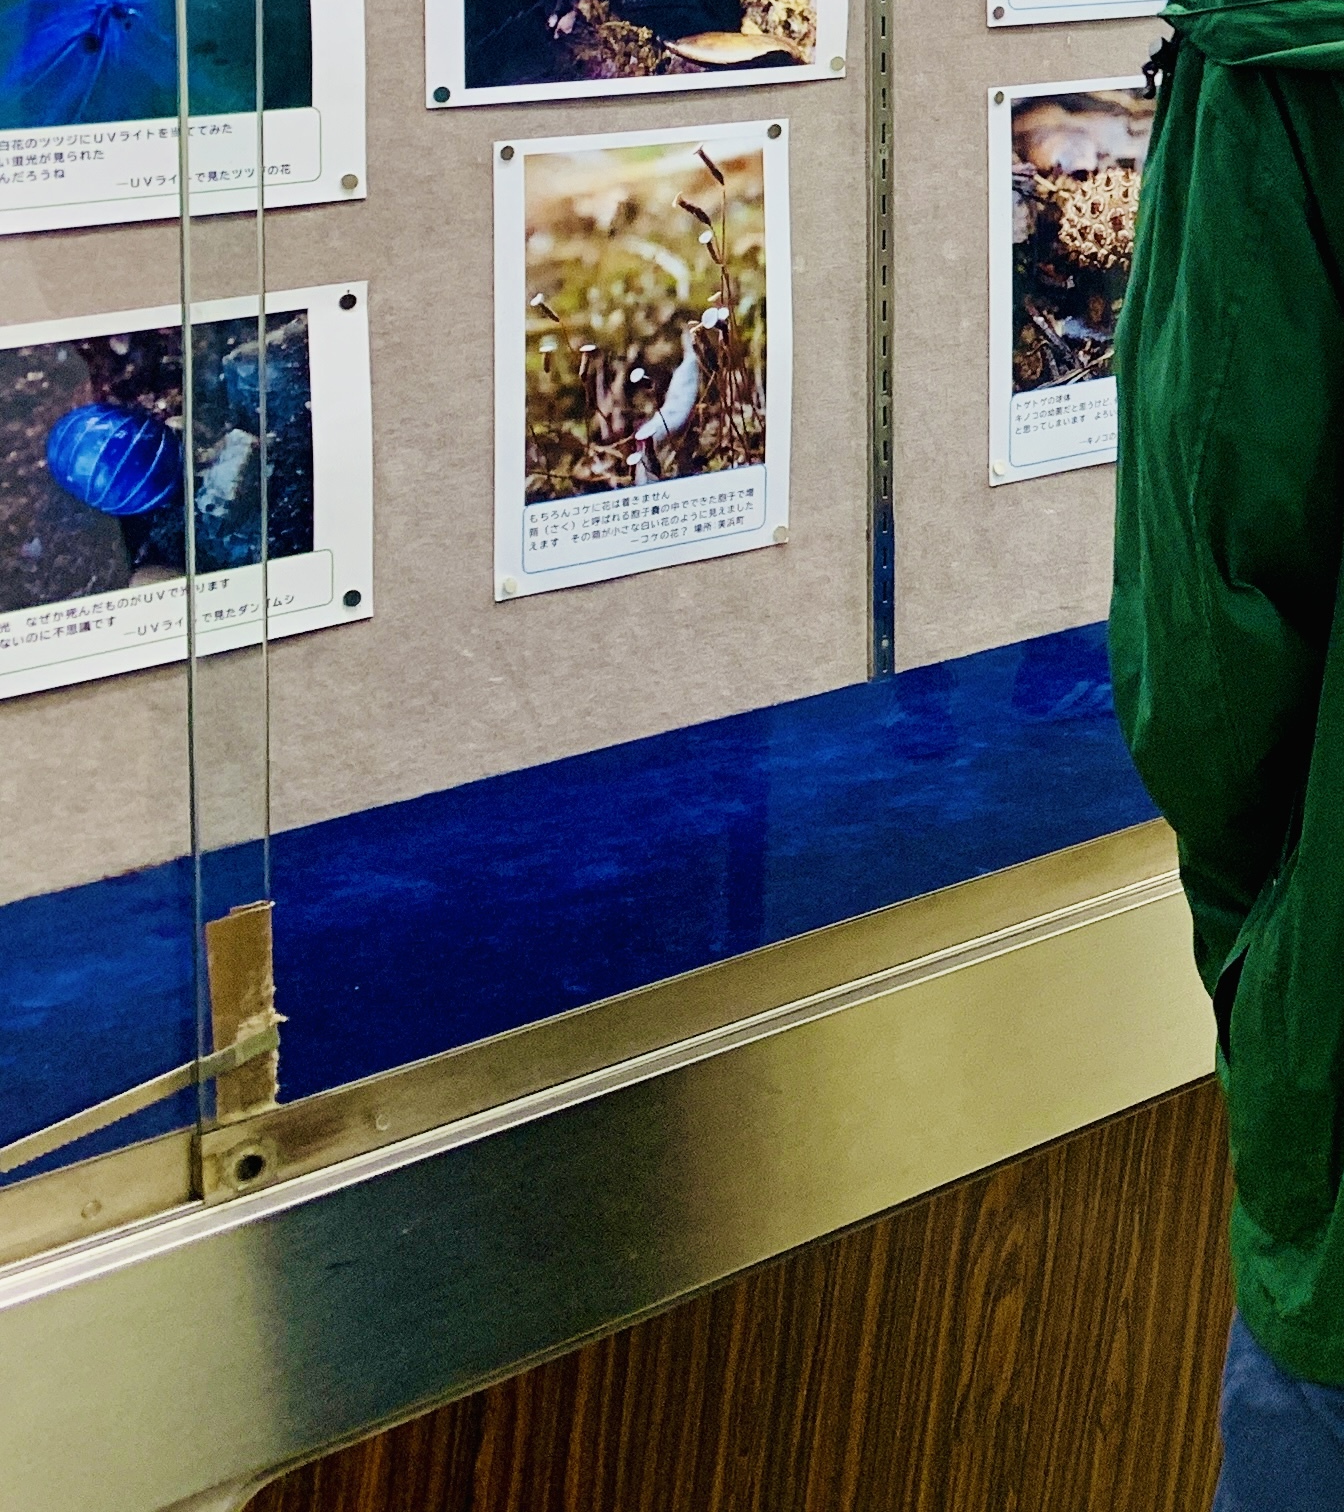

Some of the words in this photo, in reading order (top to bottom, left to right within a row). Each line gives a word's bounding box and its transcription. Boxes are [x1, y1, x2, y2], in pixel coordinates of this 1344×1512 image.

[0, 168, 65, 184] んだろうね
[1015, 414, 1086, 435] と思ってしまいます
[530, 491, 671, 523] もちろんコケに花は着きません
[528, 537, 559, 551] えます
[0, 616, 116, 648] ないのに不思議です
